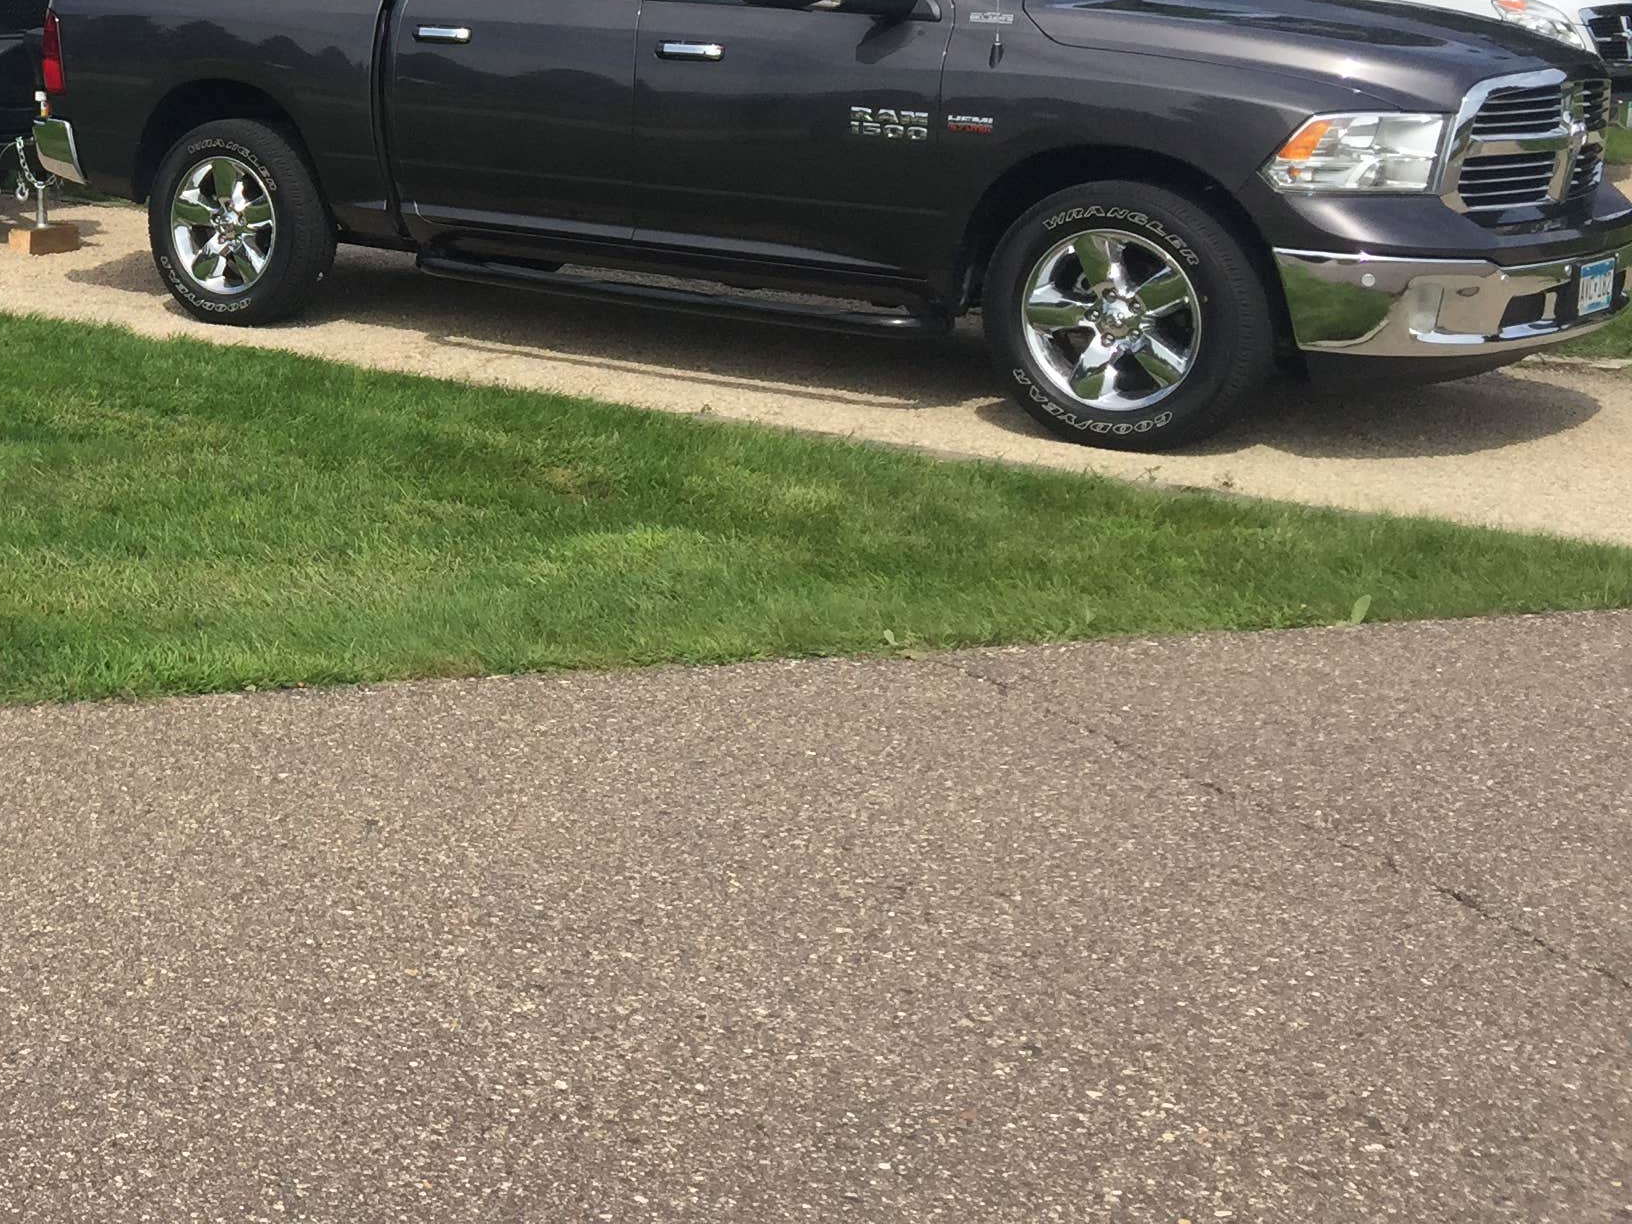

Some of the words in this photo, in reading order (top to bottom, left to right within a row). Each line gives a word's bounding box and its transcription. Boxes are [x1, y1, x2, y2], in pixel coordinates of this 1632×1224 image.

[850, 106, 929, 126] RAM
[850, 121, 928, 140] 1500
[1043, 205, 1200, 266] WRANGLER
[1013, 368, 1173, 435] GOODYEAR
